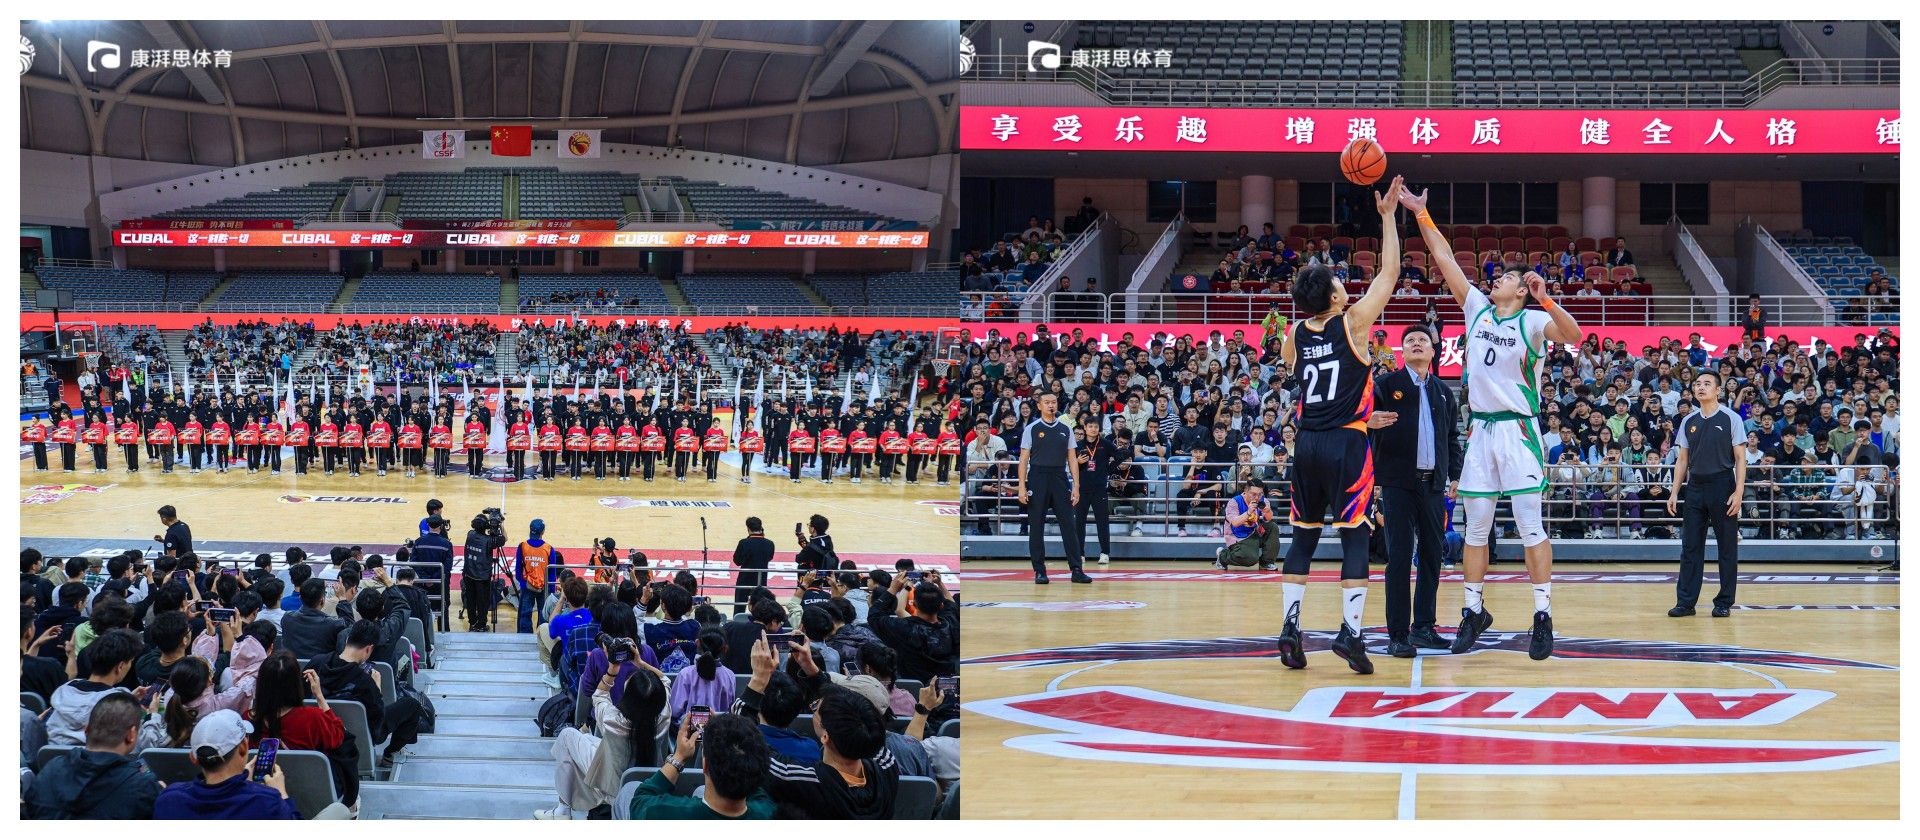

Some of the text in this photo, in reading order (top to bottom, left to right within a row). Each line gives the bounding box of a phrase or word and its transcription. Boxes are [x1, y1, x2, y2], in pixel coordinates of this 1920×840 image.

[991, 114, 1208, 144] 享受乐趣
[1284, 116, 1502, 146] 增强体质
[1579, 117, 1798, 145] 健全人格
[121, 233, 173, 244] CUBAL
[282, 233, 335, 244] CUBAL
[446, 234, 502, 245] CUBAL
[614, 234, 669, 245] CUBAL
[784, 234, 841, 245] CUBAL
[1475, 330, 1517, 347] 上海交通大学
[1484, 347, 1496, 367] 0
[1303, 359, 1340, 404] 27
[315, 496, 408, 504] CUBAL
[1329, 690, 1797, 720] ANTA
